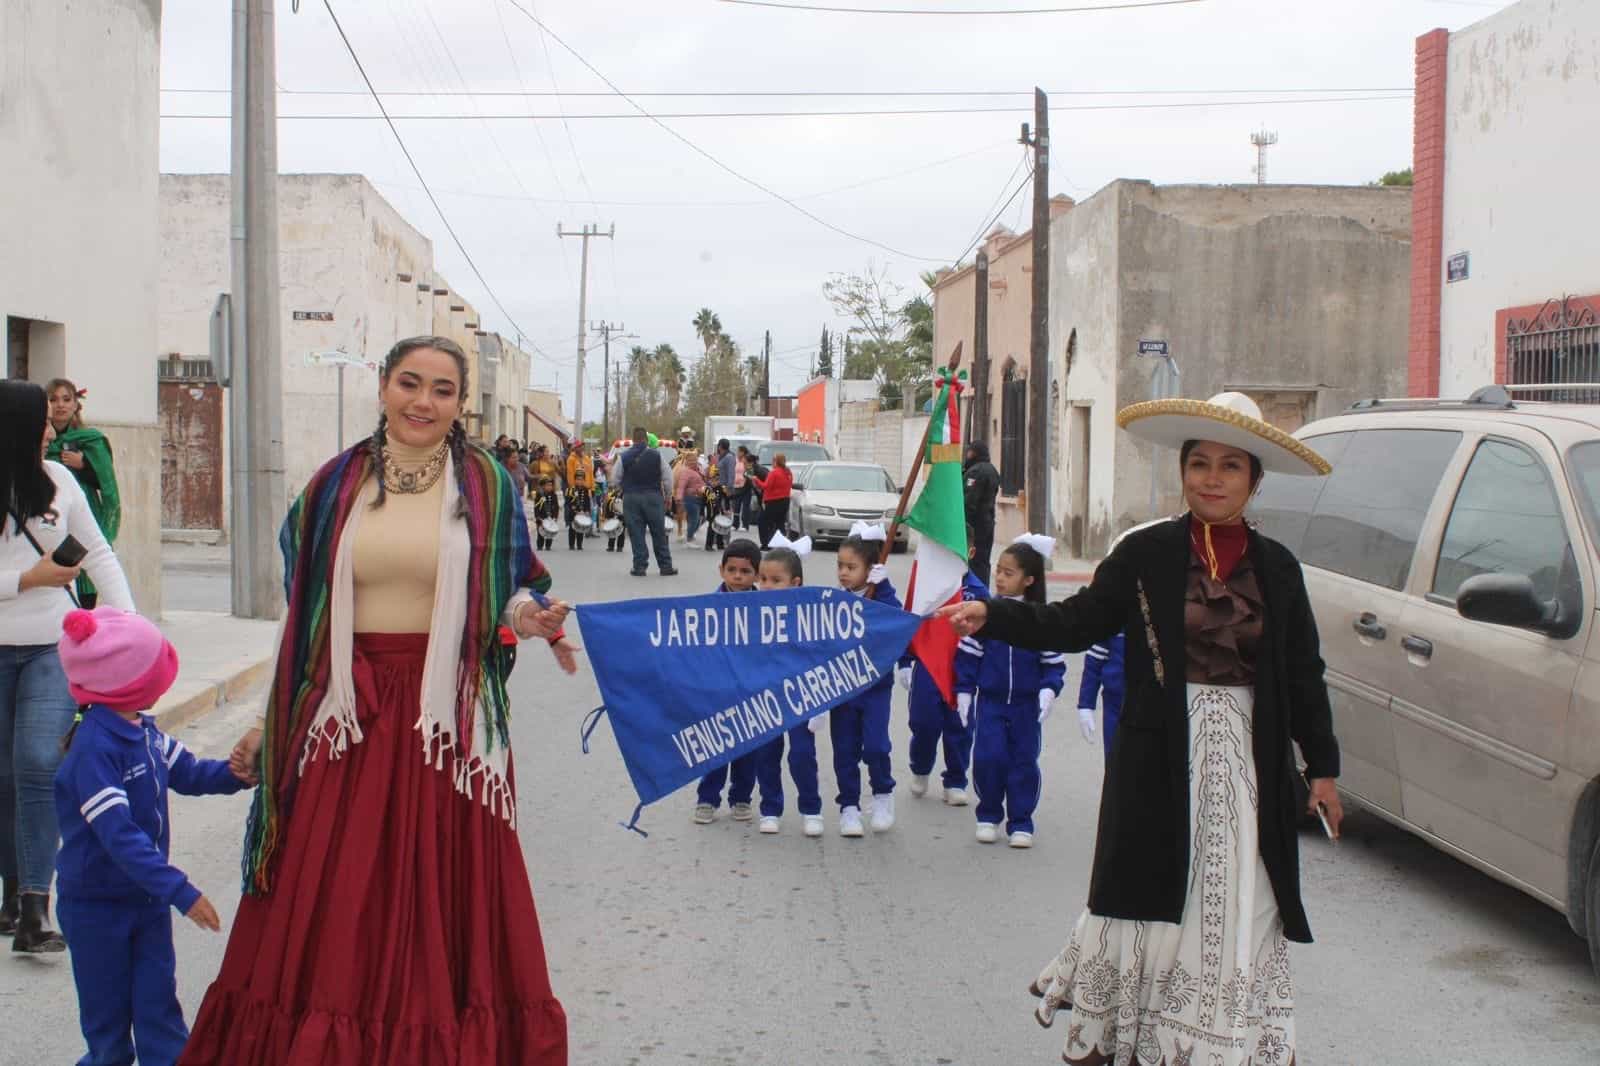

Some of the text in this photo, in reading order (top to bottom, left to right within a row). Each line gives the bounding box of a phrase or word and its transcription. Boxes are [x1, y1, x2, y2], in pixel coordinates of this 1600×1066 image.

[650, 589, 865, 647] JARDIN DE NIÑOS
[672, 646, 880, 768] VENUSTIANO CARRANZA
